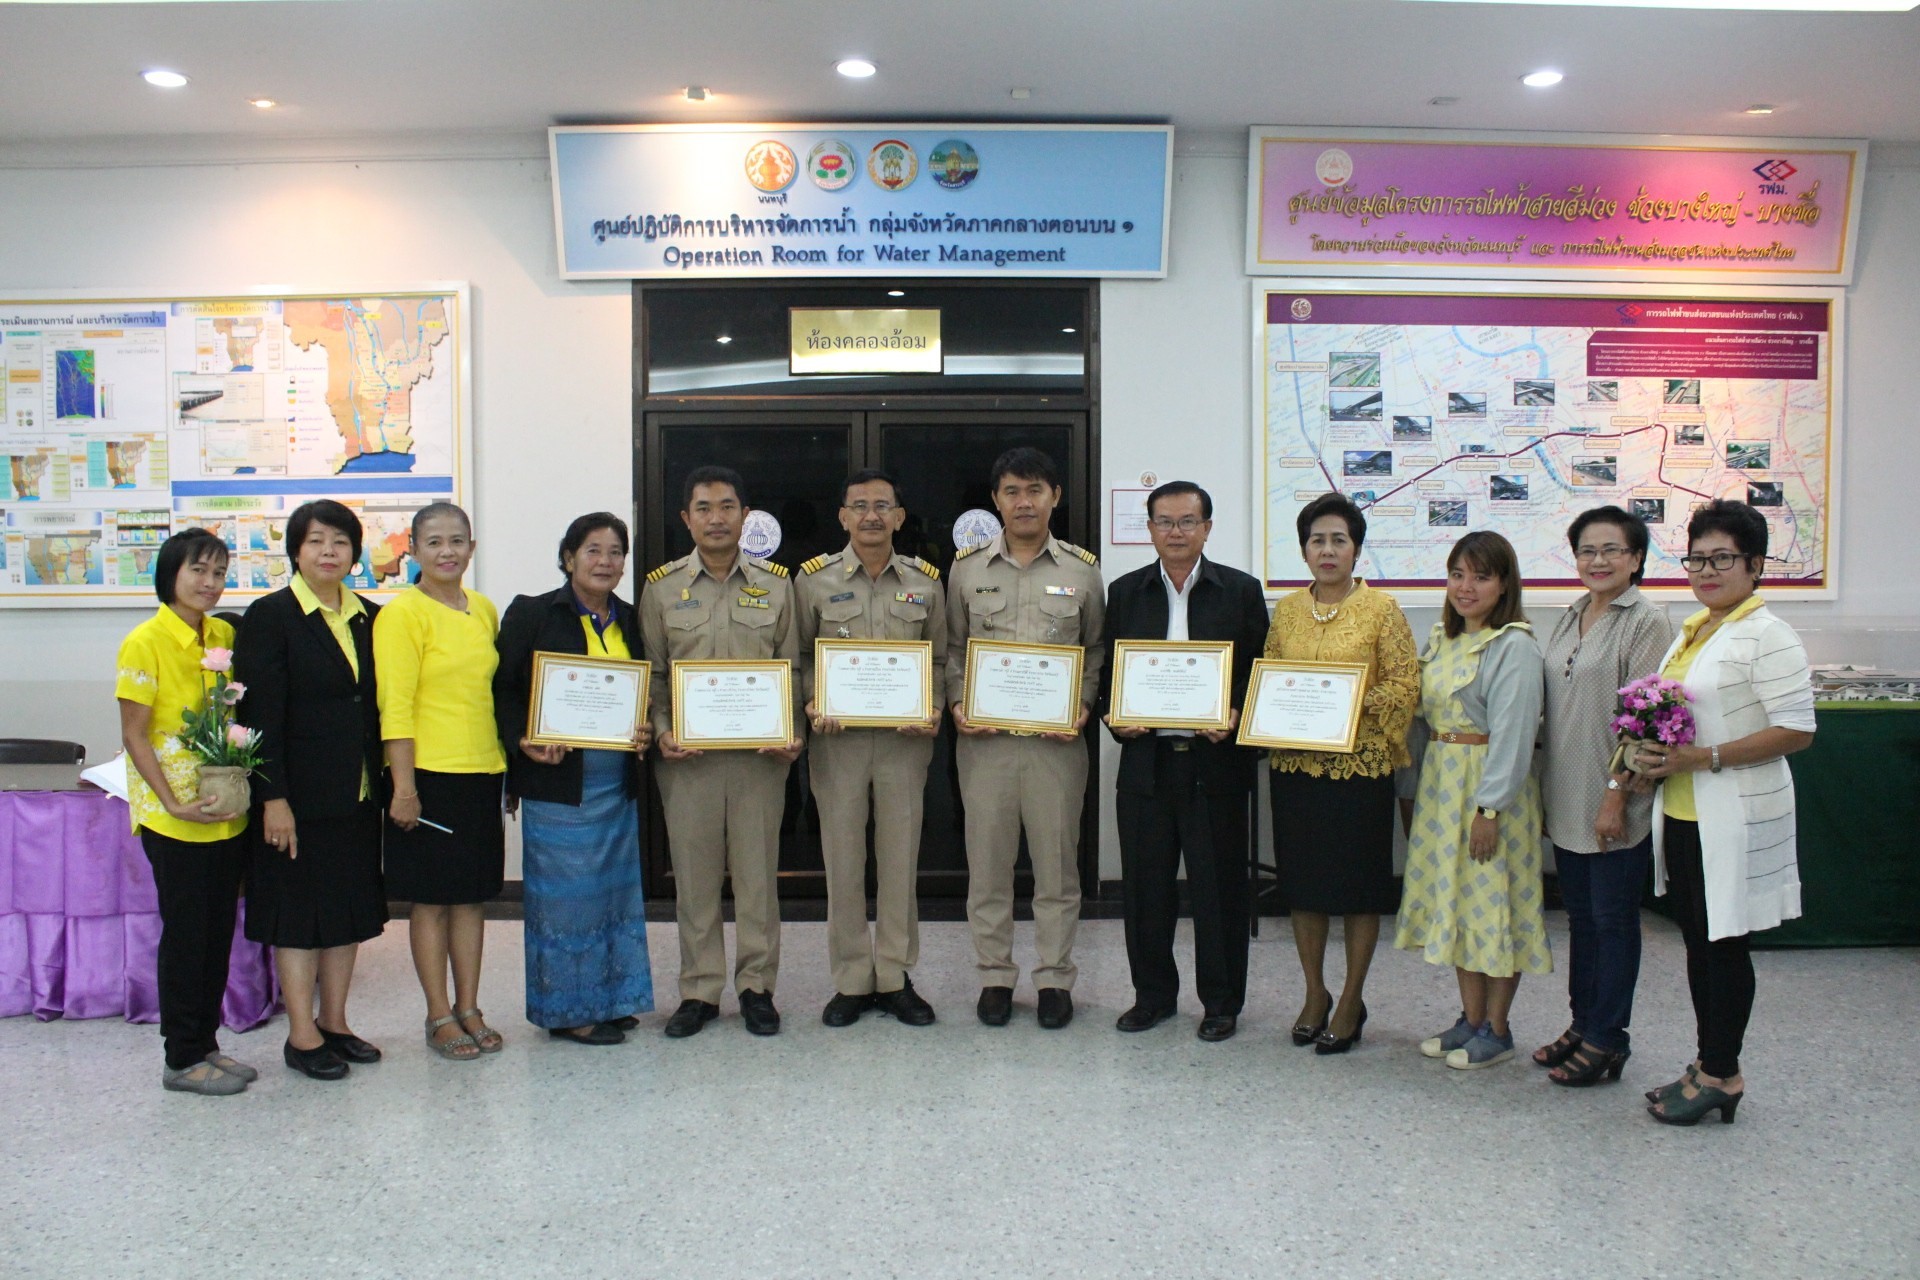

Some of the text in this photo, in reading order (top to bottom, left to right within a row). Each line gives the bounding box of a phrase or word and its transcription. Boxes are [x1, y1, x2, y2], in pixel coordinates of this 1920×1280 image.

[1758, 183, 1788, 195] รฟม.
[758, 193, 788, 207] นนทบุรี
[1289, 182, 1617, 226] ศูนย์ข้อมูลโครงการรถไฟฟ้าสายสีม่วง
[1627, 185, 1745, 226] ช่วงบางใหญ่
[1758, 180, 1821, 225] บางซื่อ
[593, 207, 1134, 242] ศูนย์ปฏิบัติการบริหารจัดการน้ำ กลุ่มจังหวัดภาคกลางตอนบน ๑
[664, 244, 1066, 270] Operation Room for Water Management
[1531, 243, 1555, 256] และ
[0, 315, 74, 326] ระเมินสถานการณ์
[806, 329, 926, 349] ห้องคลองอ้อม
